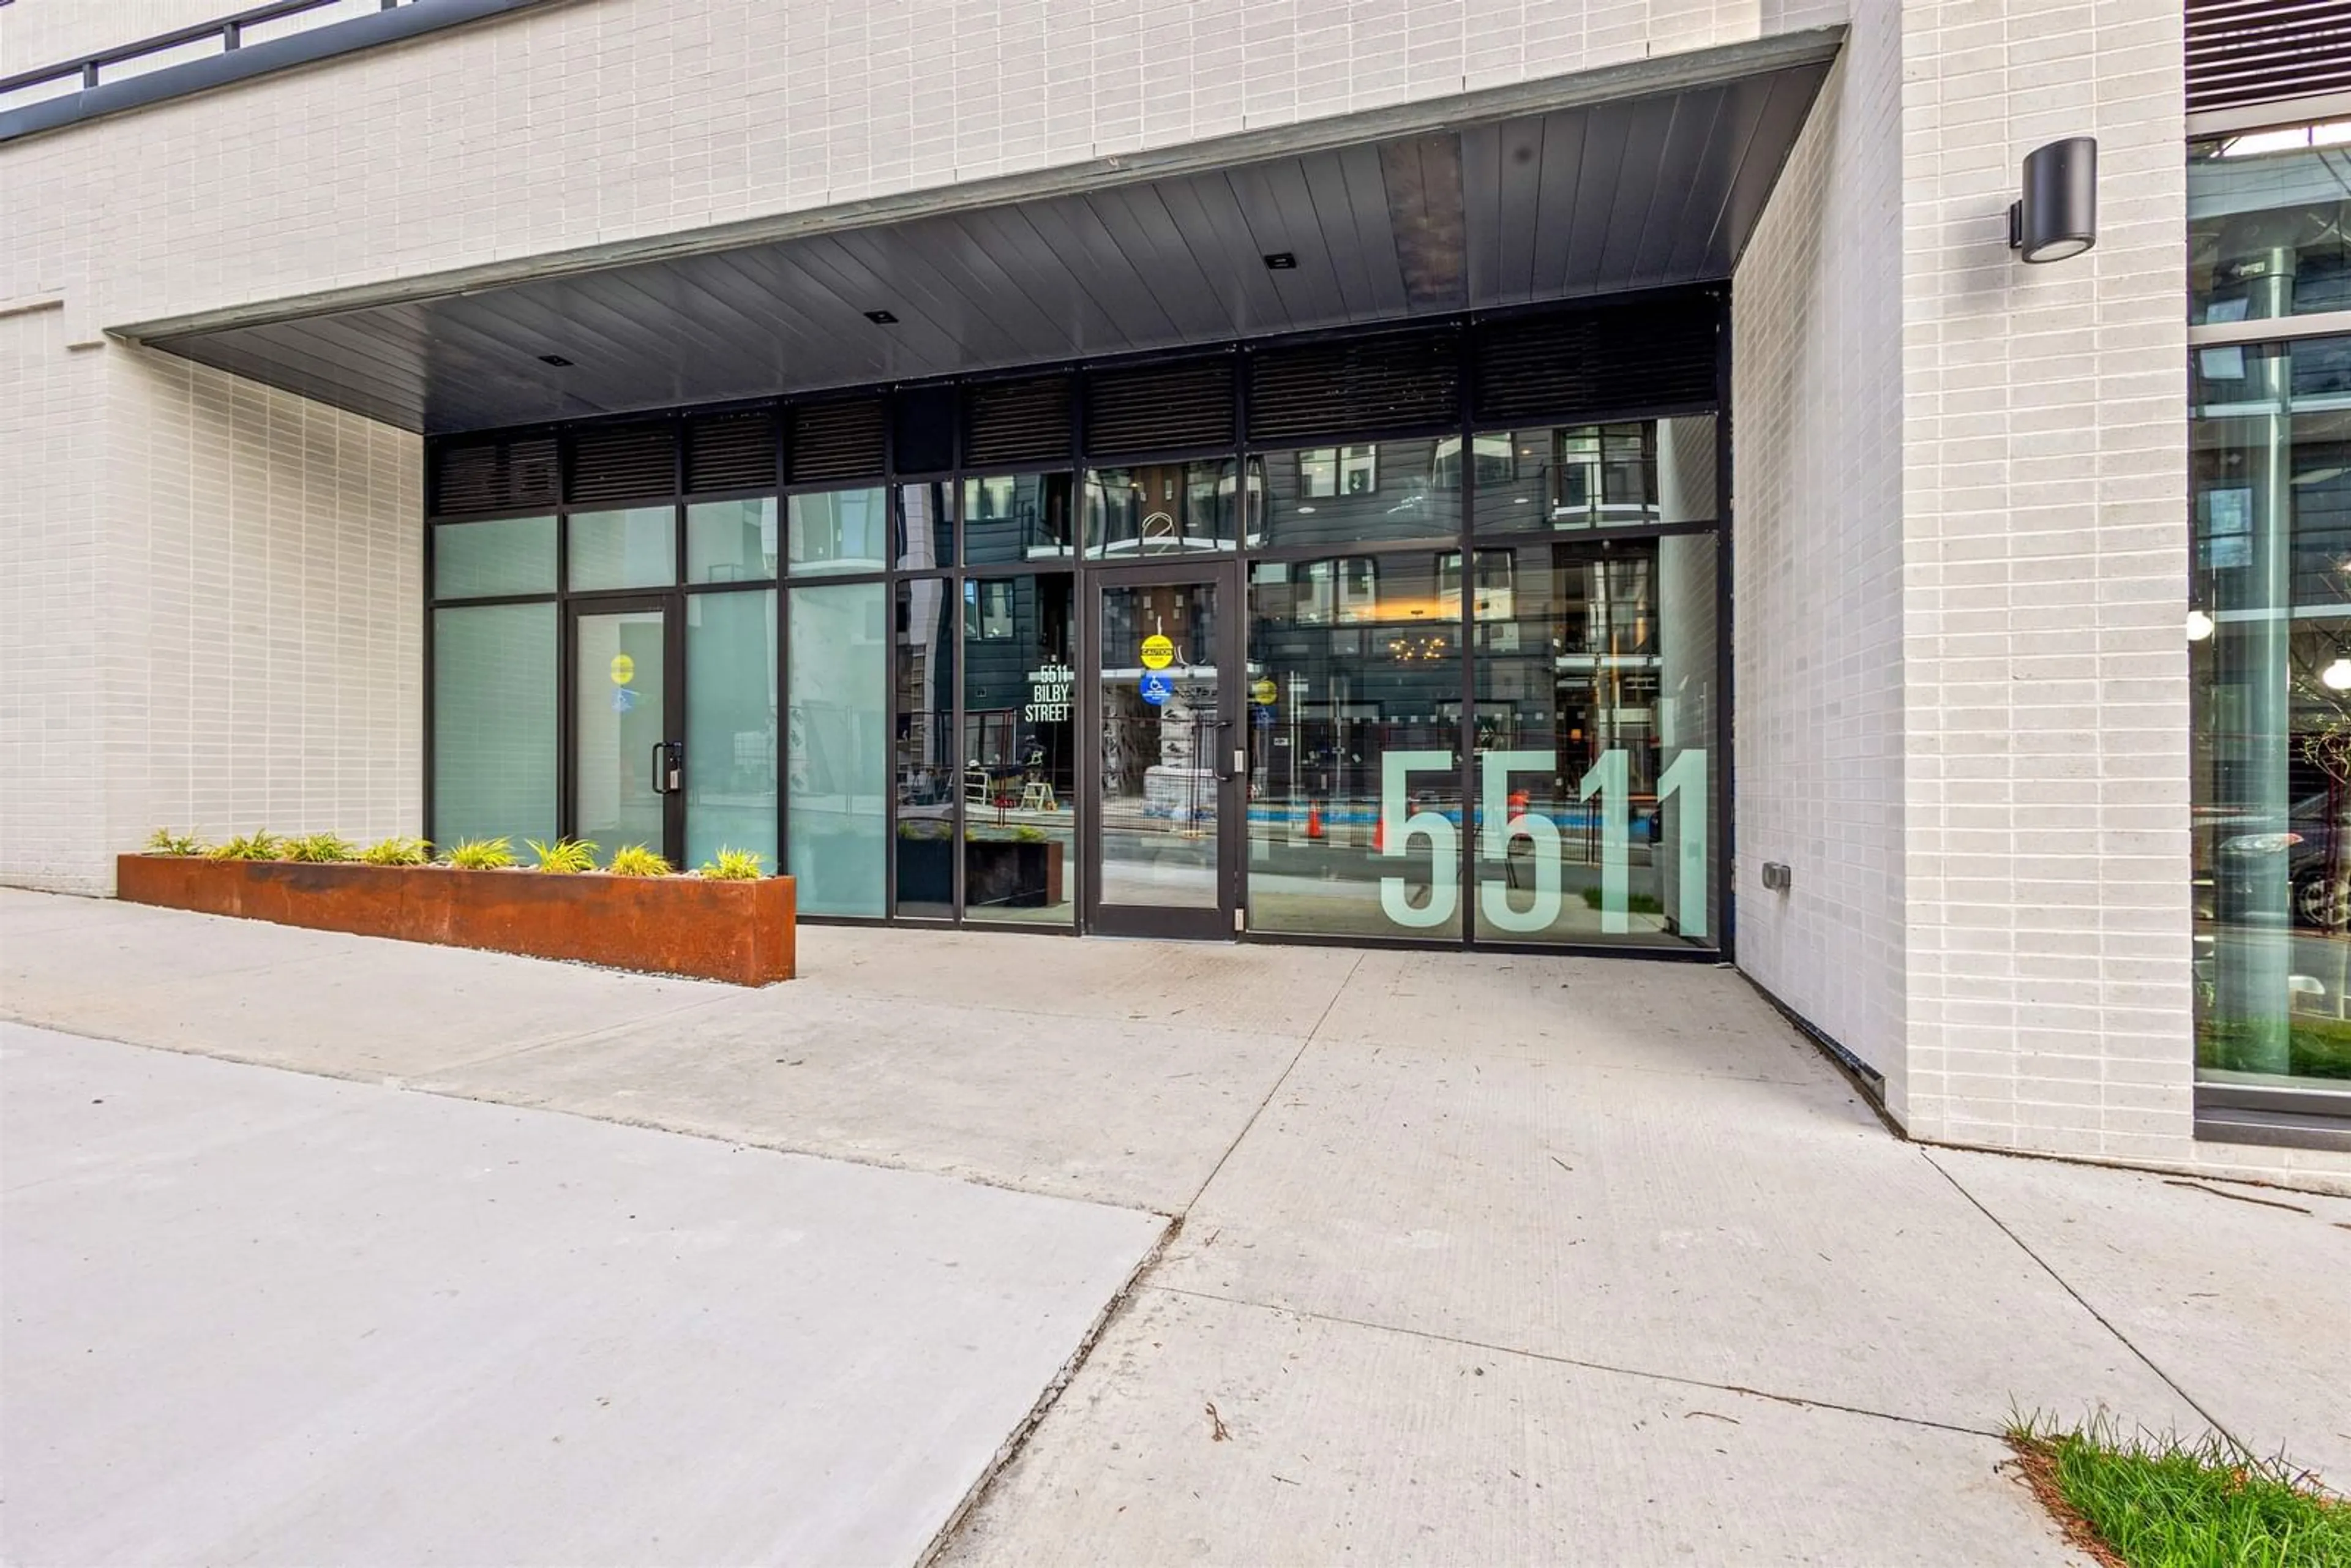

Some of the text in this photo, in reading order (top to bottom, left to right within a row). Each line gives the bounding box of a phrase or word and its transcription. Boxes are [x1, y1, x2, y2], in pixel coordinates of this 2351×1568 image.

[1041, 664, 1068, 683] 5511
[1034, 684, 1069, 702] BILBY
[1026, 703, 1070, 722] STREET
[1381, 749, 1707, 937] 5511
